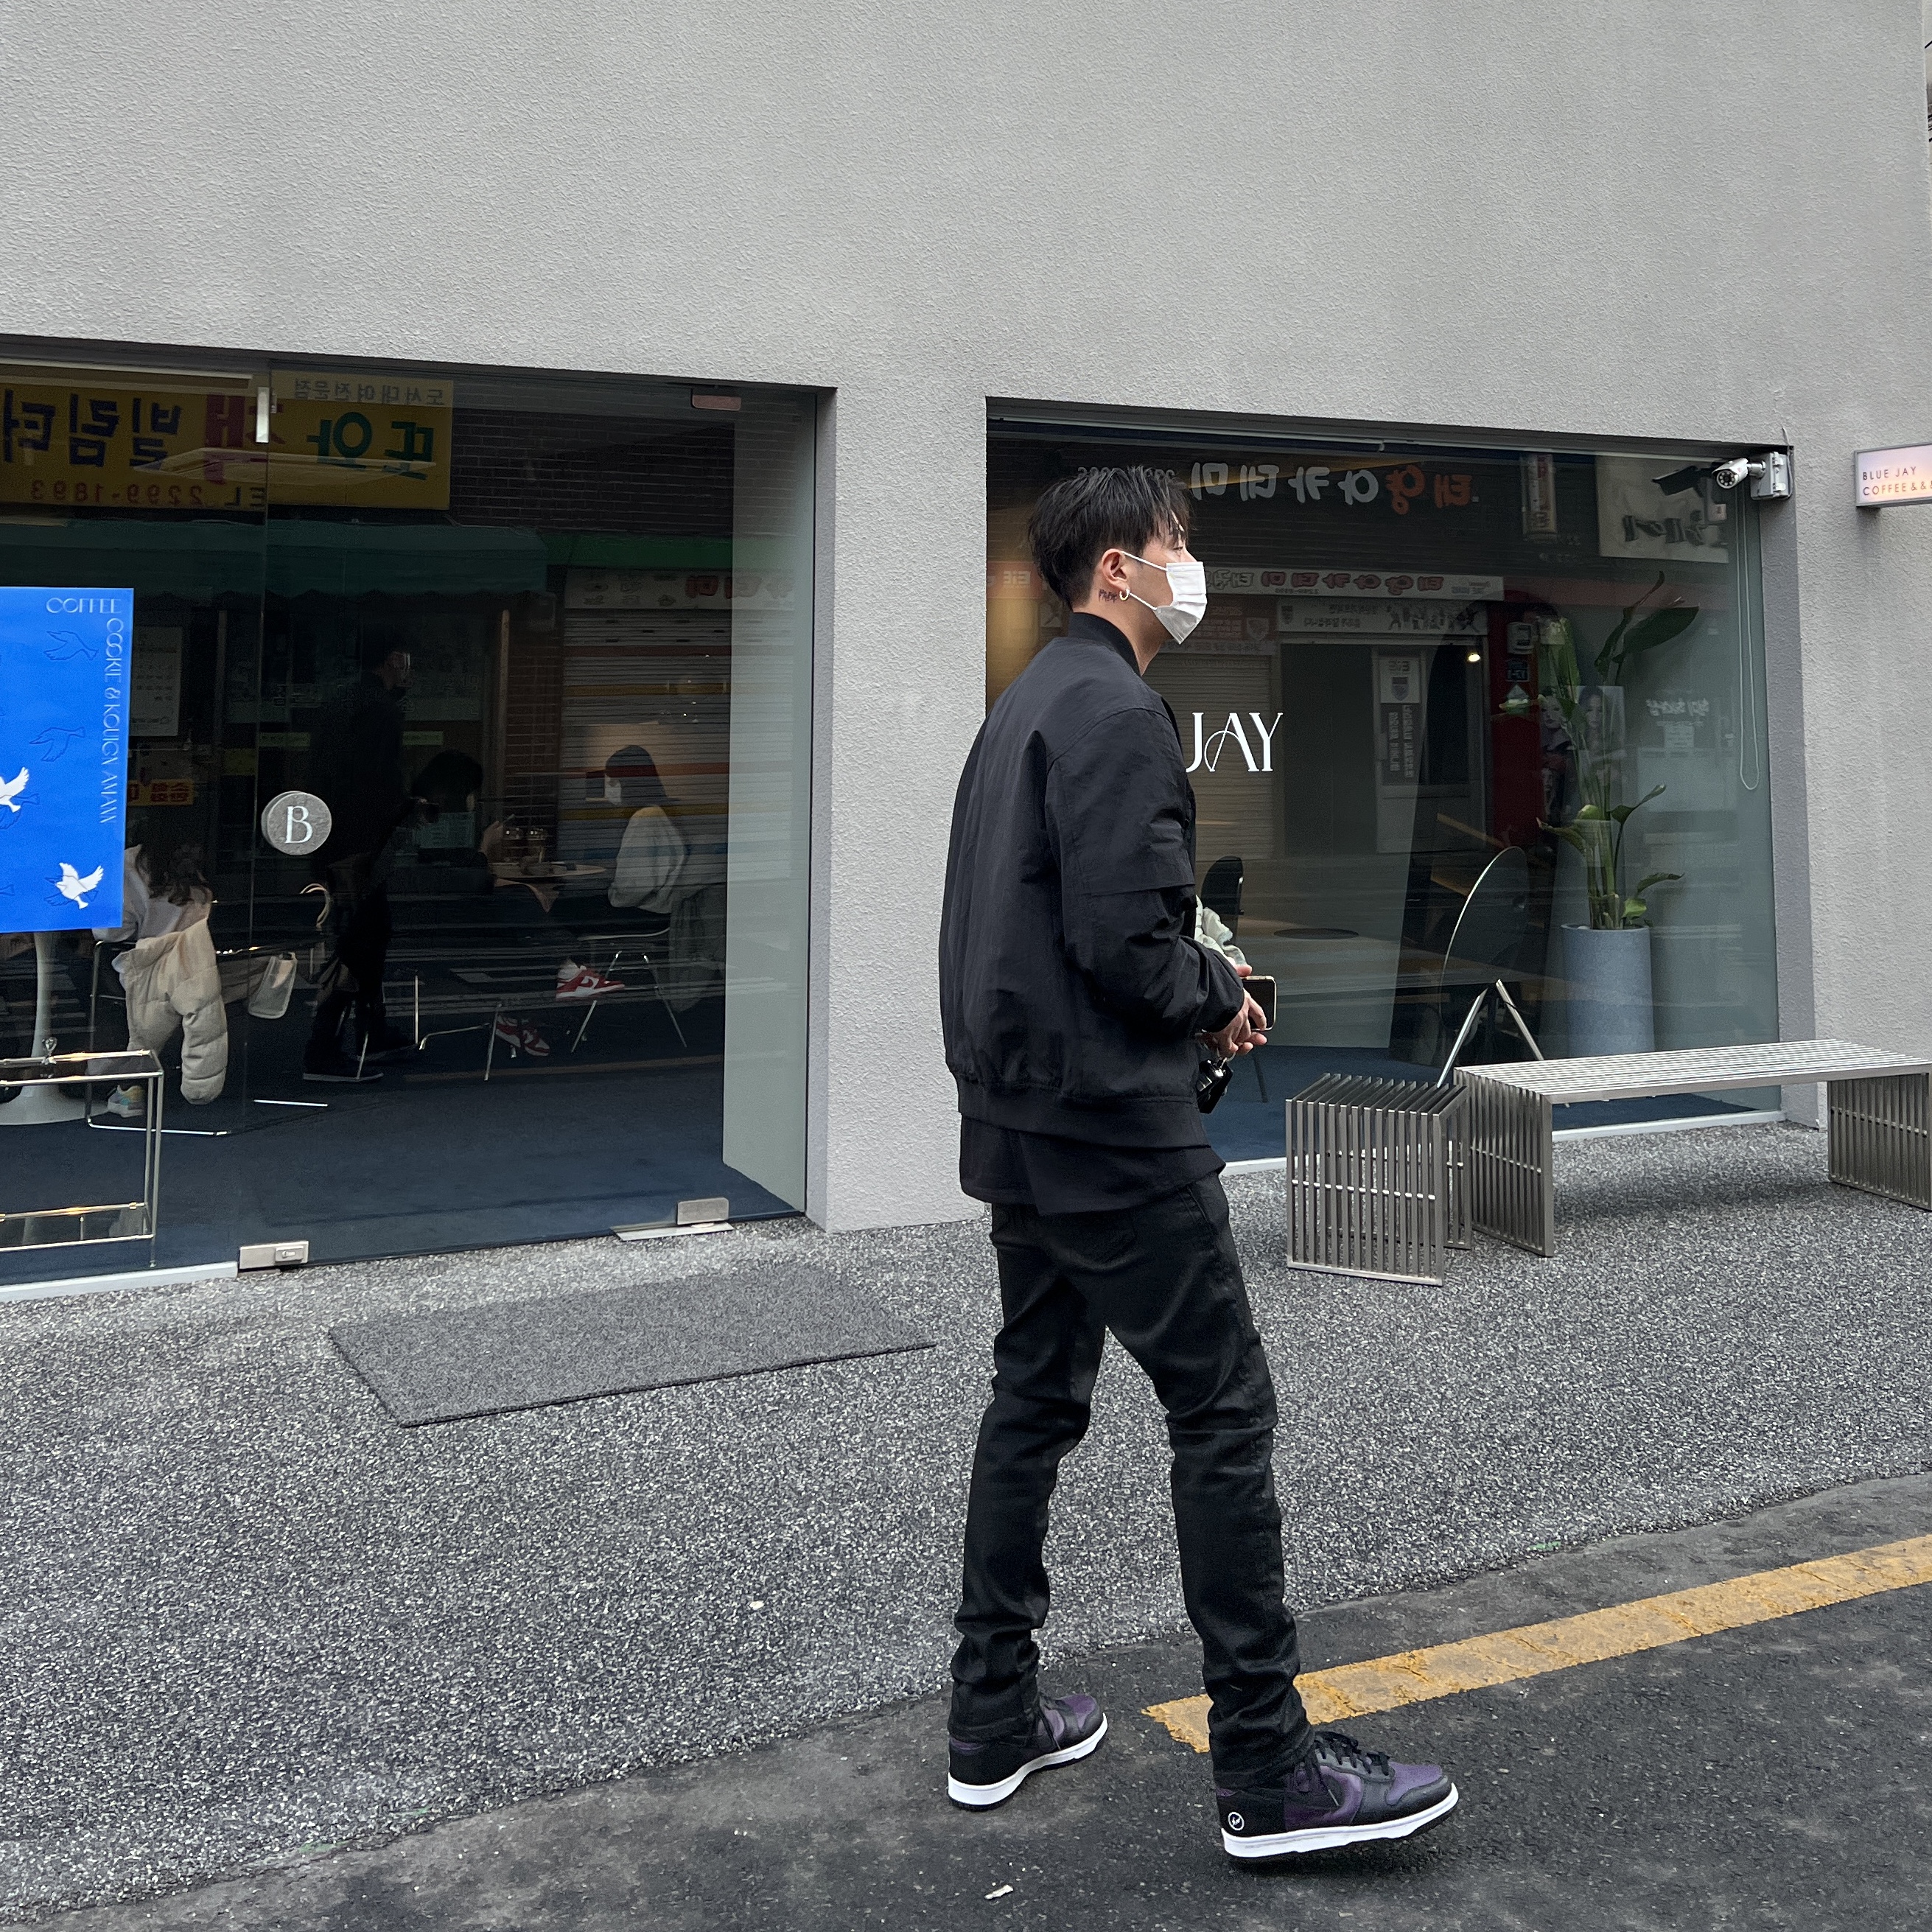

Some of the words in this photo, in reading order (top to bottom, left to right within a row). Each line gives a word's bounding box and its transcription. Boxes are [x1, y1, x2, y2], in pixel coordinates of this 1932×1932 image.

[1863, 469, 1889, 480] BLUE
[1896, 466, 1916, 477] JAY
[1863, 483, 1906, 495] COFFEE
[1911, 483, 1917, 491] &
[1921, 481, 1926, 489] &
[46, 597, 123, 615] COFFEE
[105, 617, 124, 683] COOKIE
[105, 687, 120, 699] &
[102, 704, 120, 766] KOUIGN
[1186, 712, 1284, 773] JAY
[285, 805, 313, 844] B
